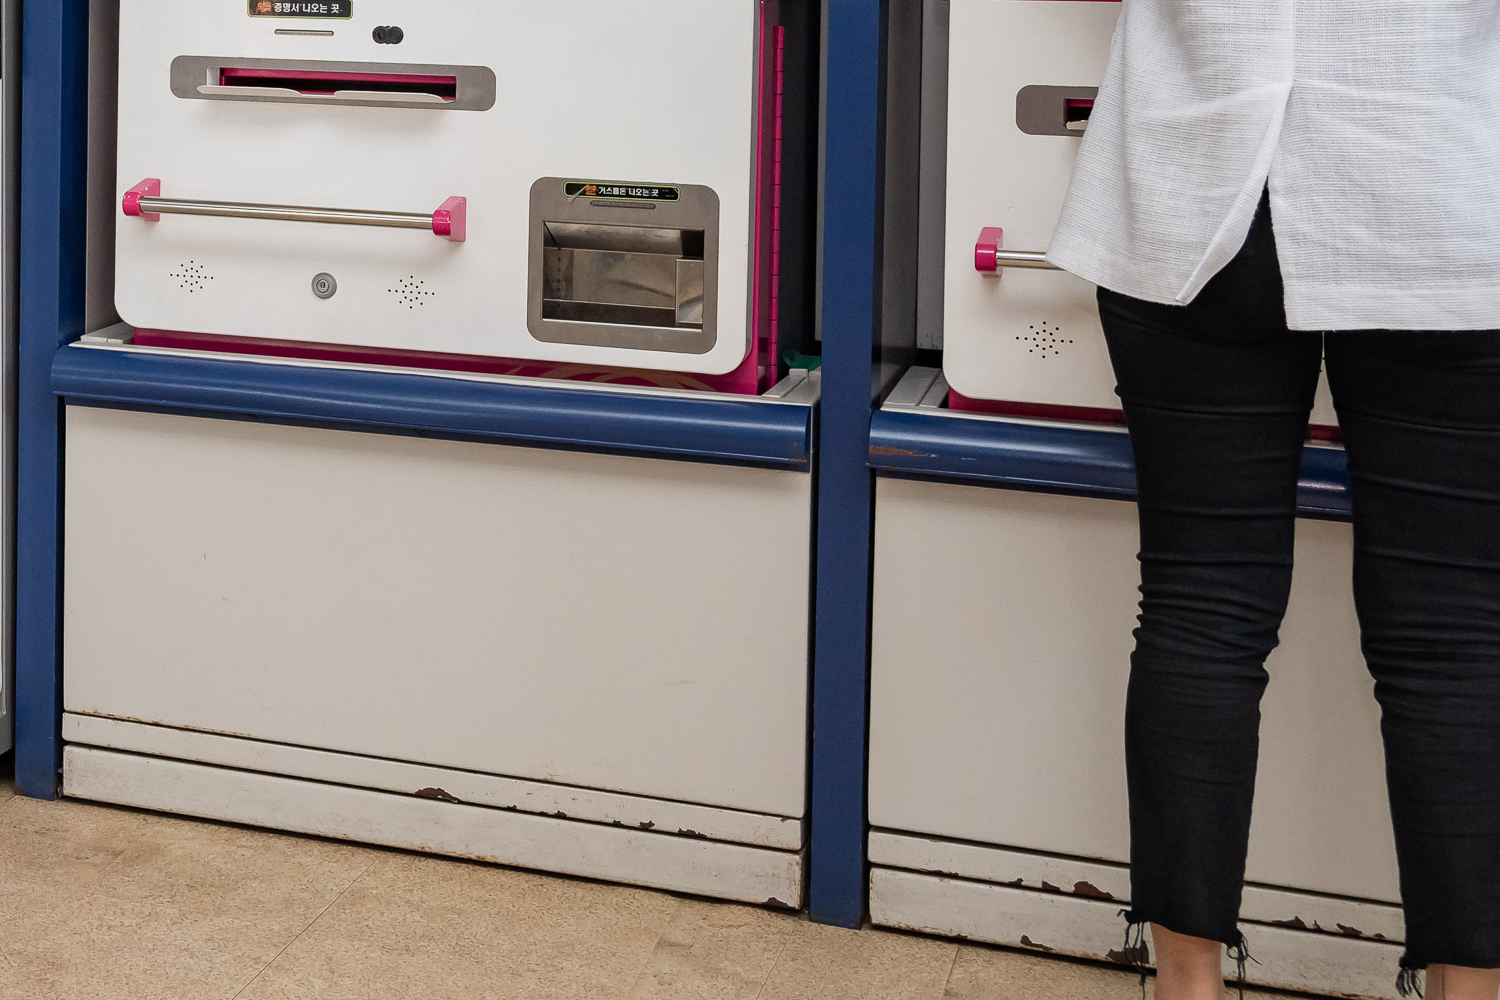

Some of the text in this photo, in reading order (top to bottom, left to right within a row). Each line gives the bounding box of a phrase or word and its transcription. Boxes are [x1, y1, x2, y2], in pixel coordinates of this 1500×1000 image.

[274, 2, 340, 14] 증명서 나오는 곳
